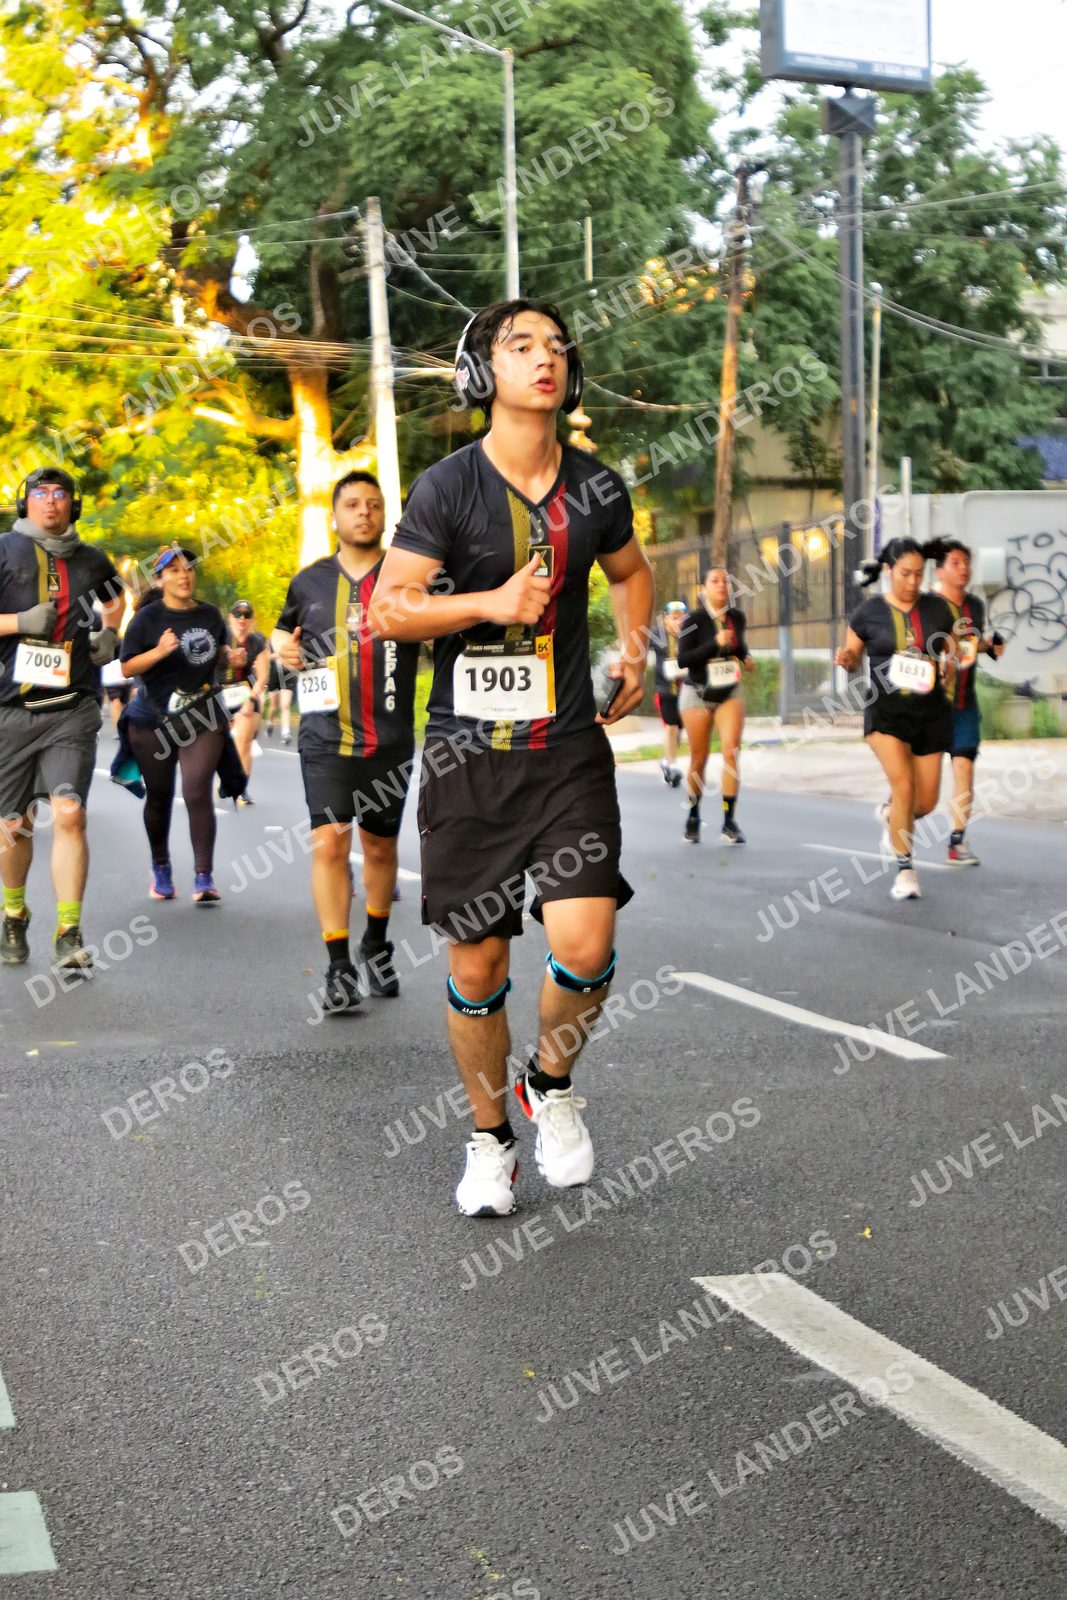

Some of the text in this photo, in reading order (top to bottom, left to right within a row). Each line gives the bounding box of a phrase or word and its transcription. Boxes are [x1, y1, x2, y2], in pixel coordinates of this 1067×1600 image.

[537, 643, 549, 652] 5K
[25, 651, 62, 669] 7009
[301, 675, 328, 694] 5236
[465, 665, 532, 692] 1903
